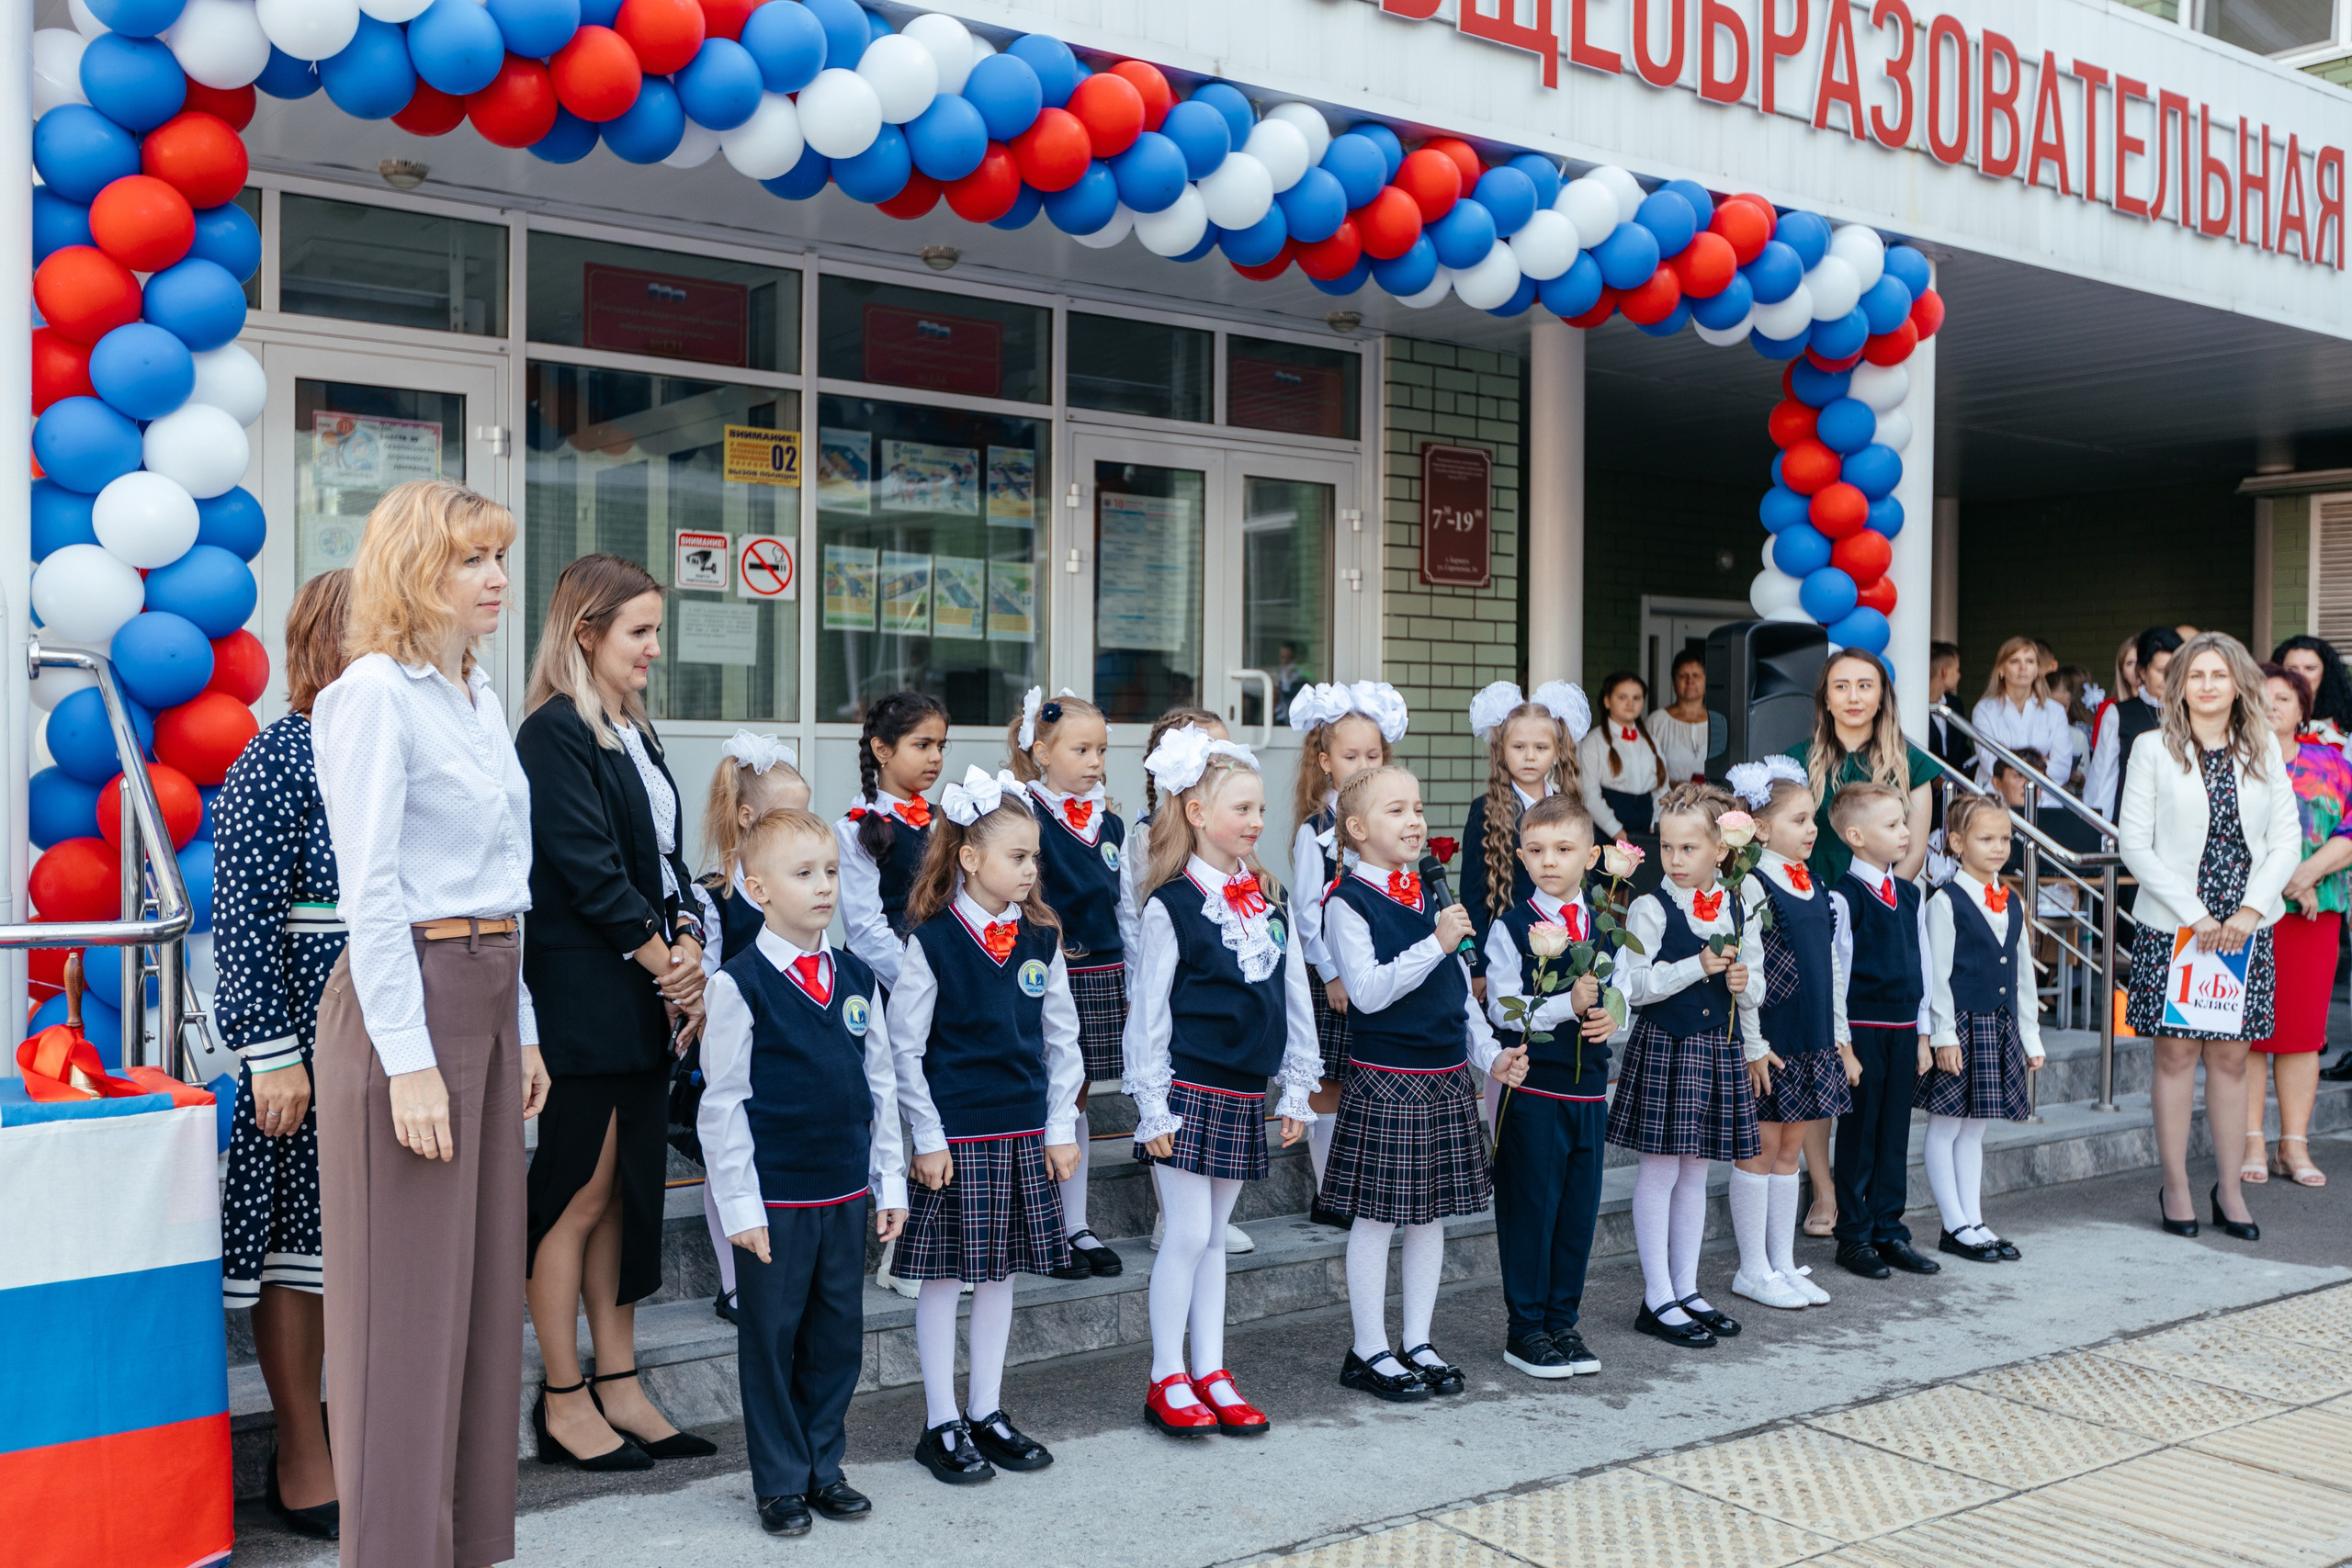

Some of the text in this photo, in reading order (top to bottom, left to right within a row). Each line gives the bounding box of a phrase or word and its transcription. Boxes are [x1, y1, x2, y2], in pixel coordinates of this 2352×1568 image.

[1378, 0, 2346, 272] ОБРАЗОВАТЕЛЬНАЯ
[729, 429, 797, 444] ВНИМАНИЕ!
[772, 444, 797, 472] 02
[760, 471, 798, 480] ПОЛИЦИИ
[681, 536, 726, 548] ВНИМАНИЕ!
[2172, 963, 2240, 1005] 1 «Б»
[2193, 999, 2239, 1012] класс
